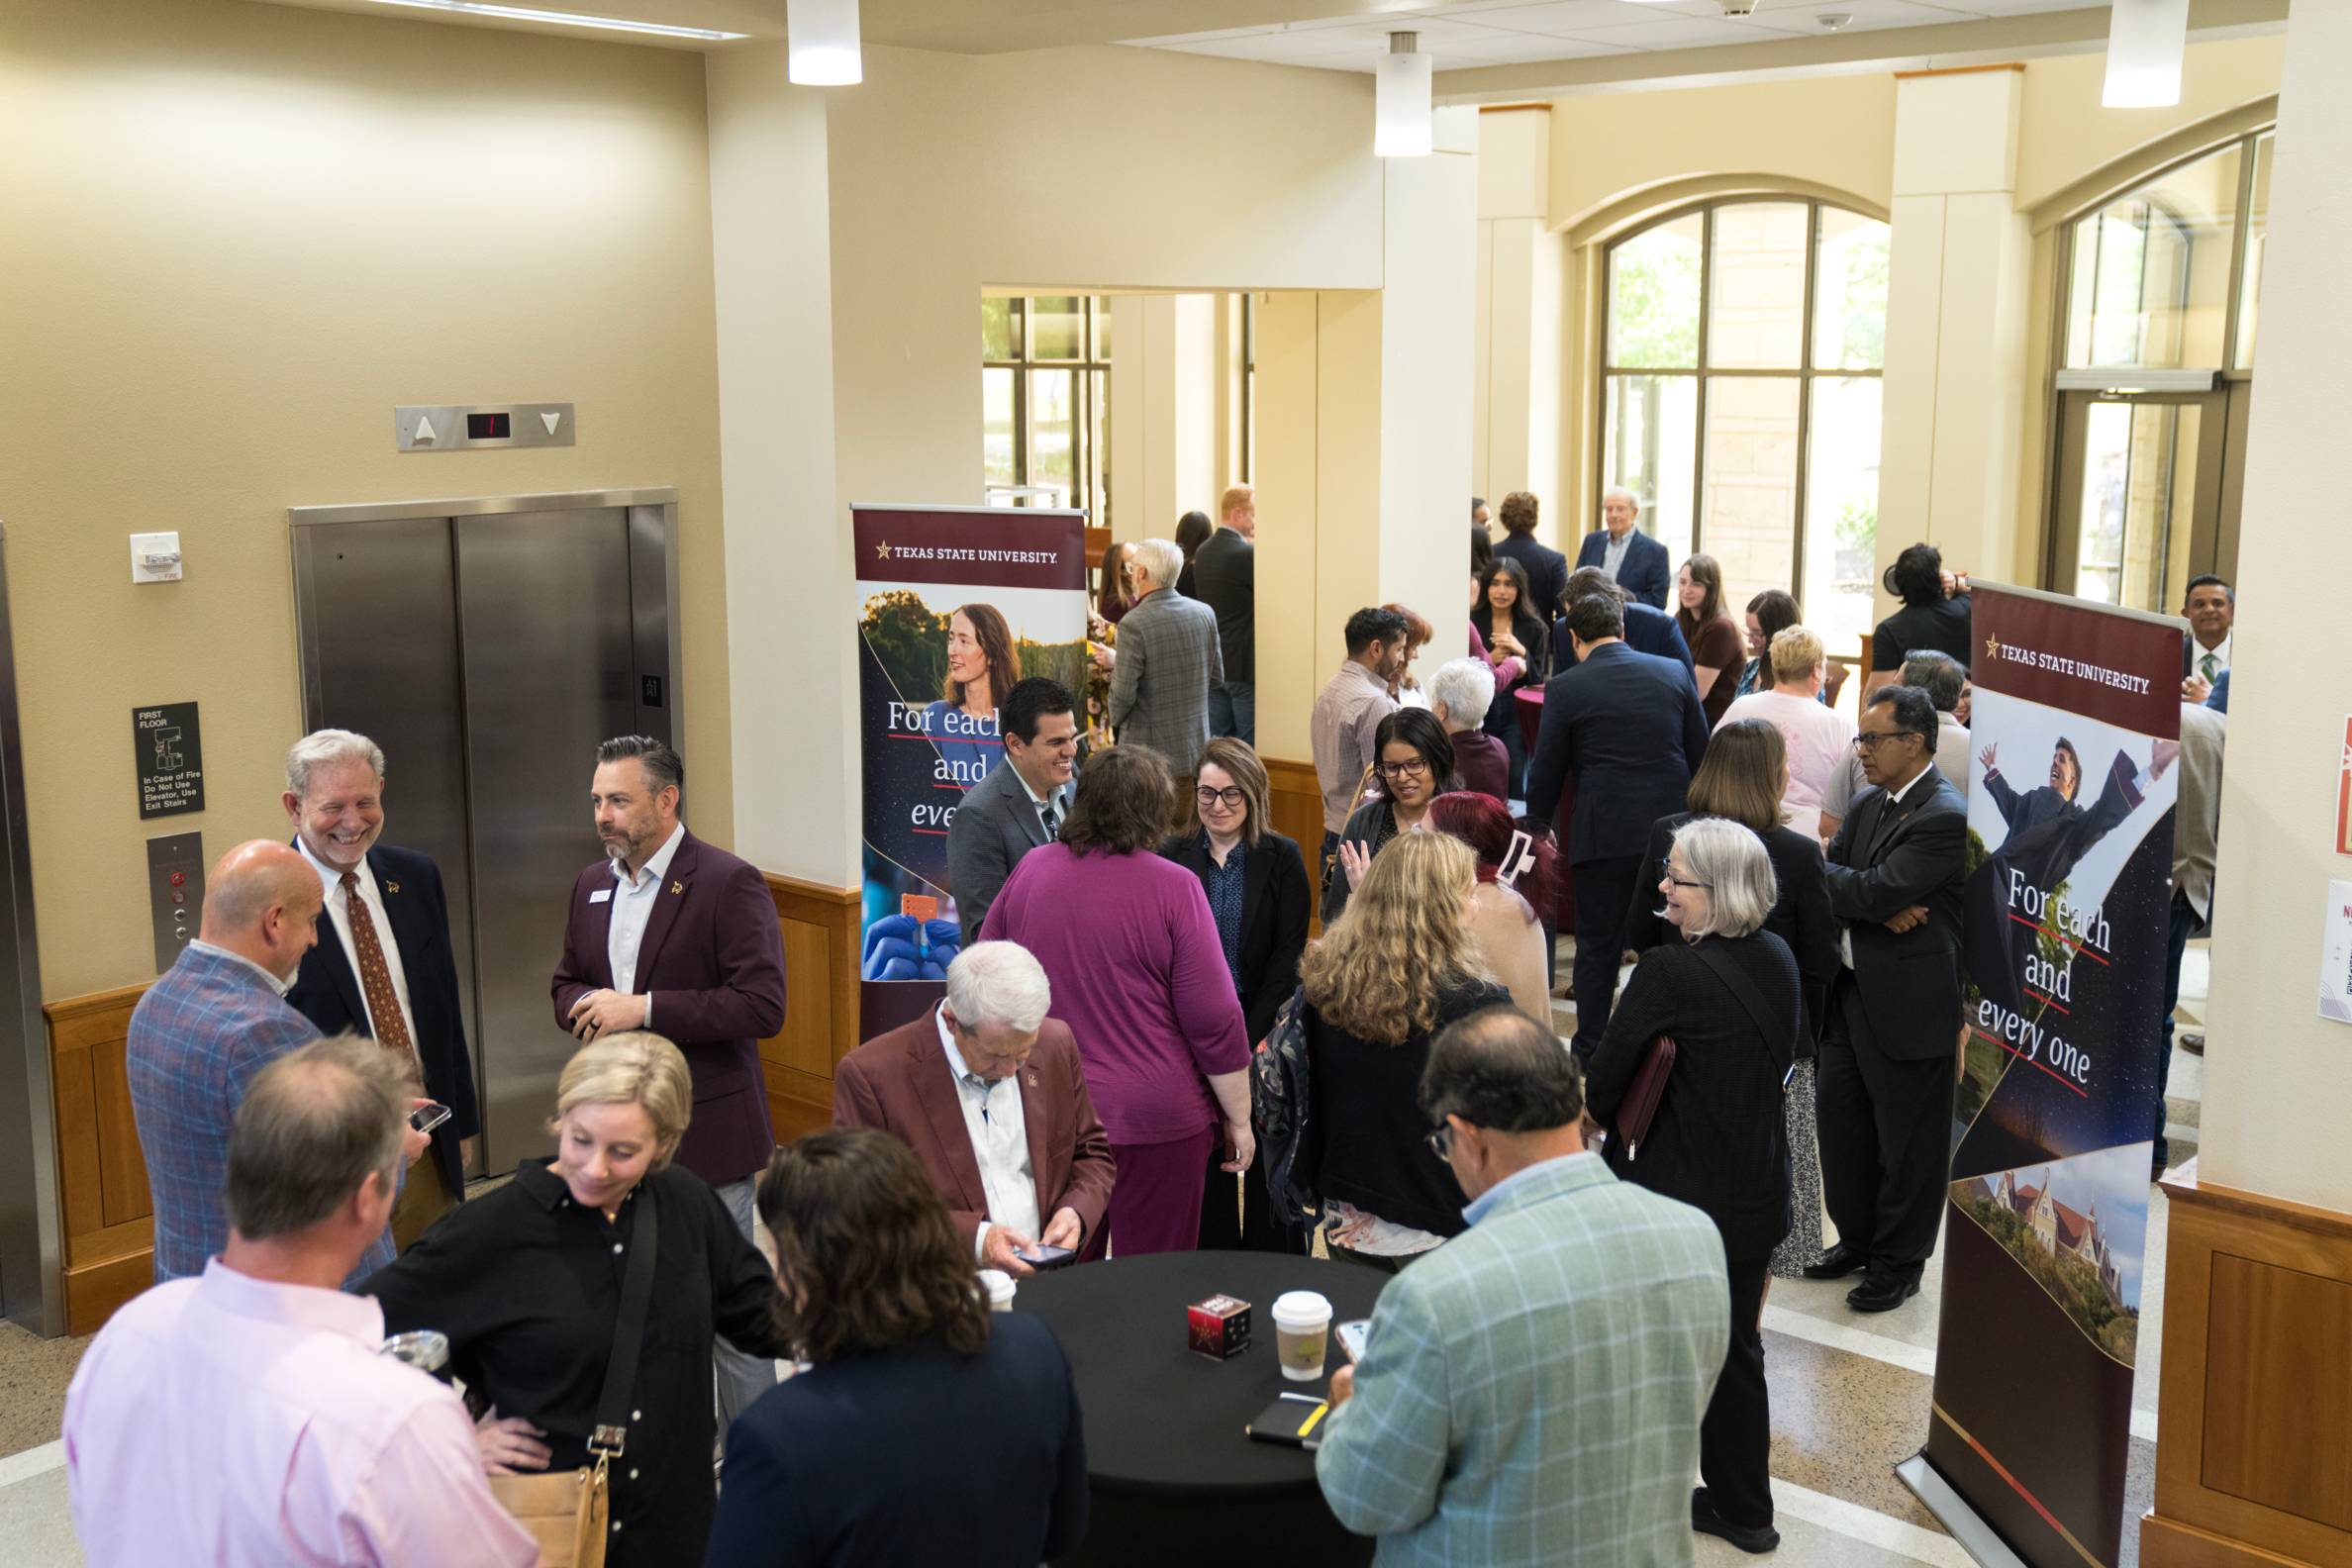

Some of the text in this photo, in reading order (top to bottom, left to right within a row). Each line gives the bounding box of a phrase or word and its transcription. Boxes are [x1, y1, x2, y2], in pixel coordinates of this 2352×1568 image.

[894, 546, 1057, 564] TEXAS STATE UNIVERSITY
[2001, 643, 2150, 694] TEXAS STATE UNIVERSITY
[139, 710, 162, 721] FIRST
[140, 719, 167, 729] FLOOR
[887, 701, 935, 733] For
[152, 775, 173, 784] Case
[175, 772, 184, 781] of
[186, 770, 201, 779] Fire
[933, 753, 988, 783] and
[144, 780, 190, 794] Do Not Use
[181, 788, 197, 798] Use
[145, 798, 187, 811] Exit Stairs
[911, 803, 957, 828] eve
[2008, 867, 2110, 953] For each
[2024, 953, 2072, 1003] and
[1978, 998, 2091, 1084] every one
